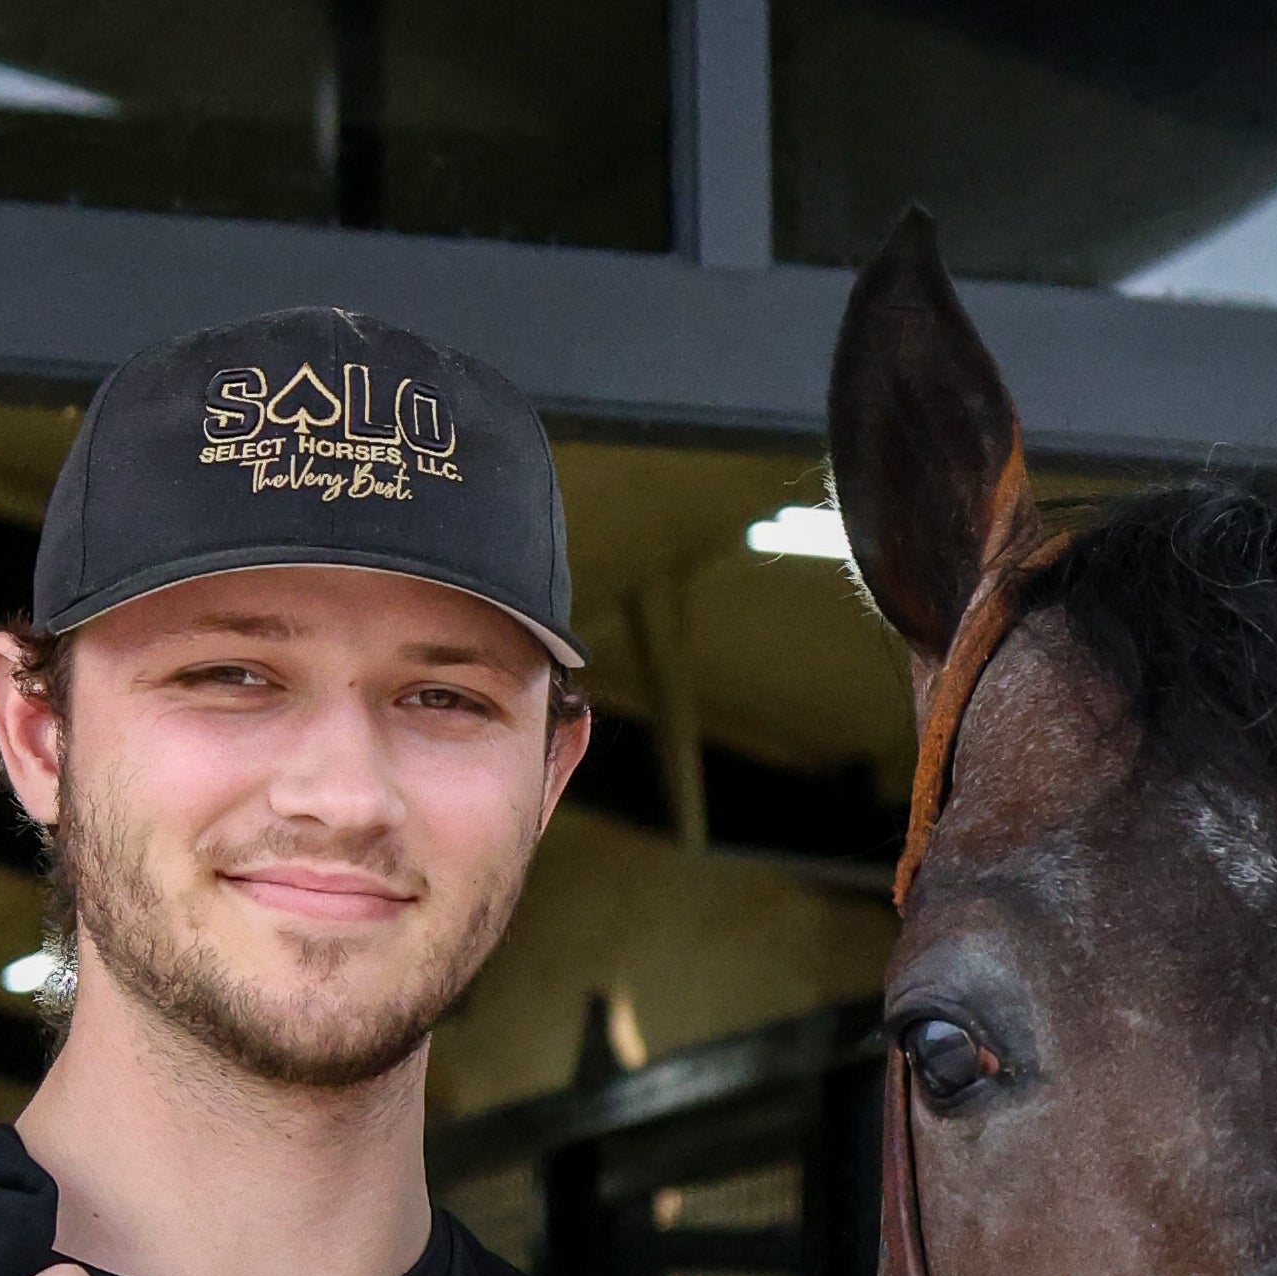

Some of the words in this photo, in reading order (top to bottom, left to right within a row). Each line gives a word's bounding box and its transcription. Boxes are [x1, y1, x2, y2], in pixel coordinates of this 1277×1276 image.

[199, 436, 287, 464] SELECT
[298, 434, 408, 470] HORSES,
[417, 454, 464, 483] LLC.
[239, 457, 289, 494] The
[290, 454, 349, 502] Very
[347, 461, 414, 501] Best.
